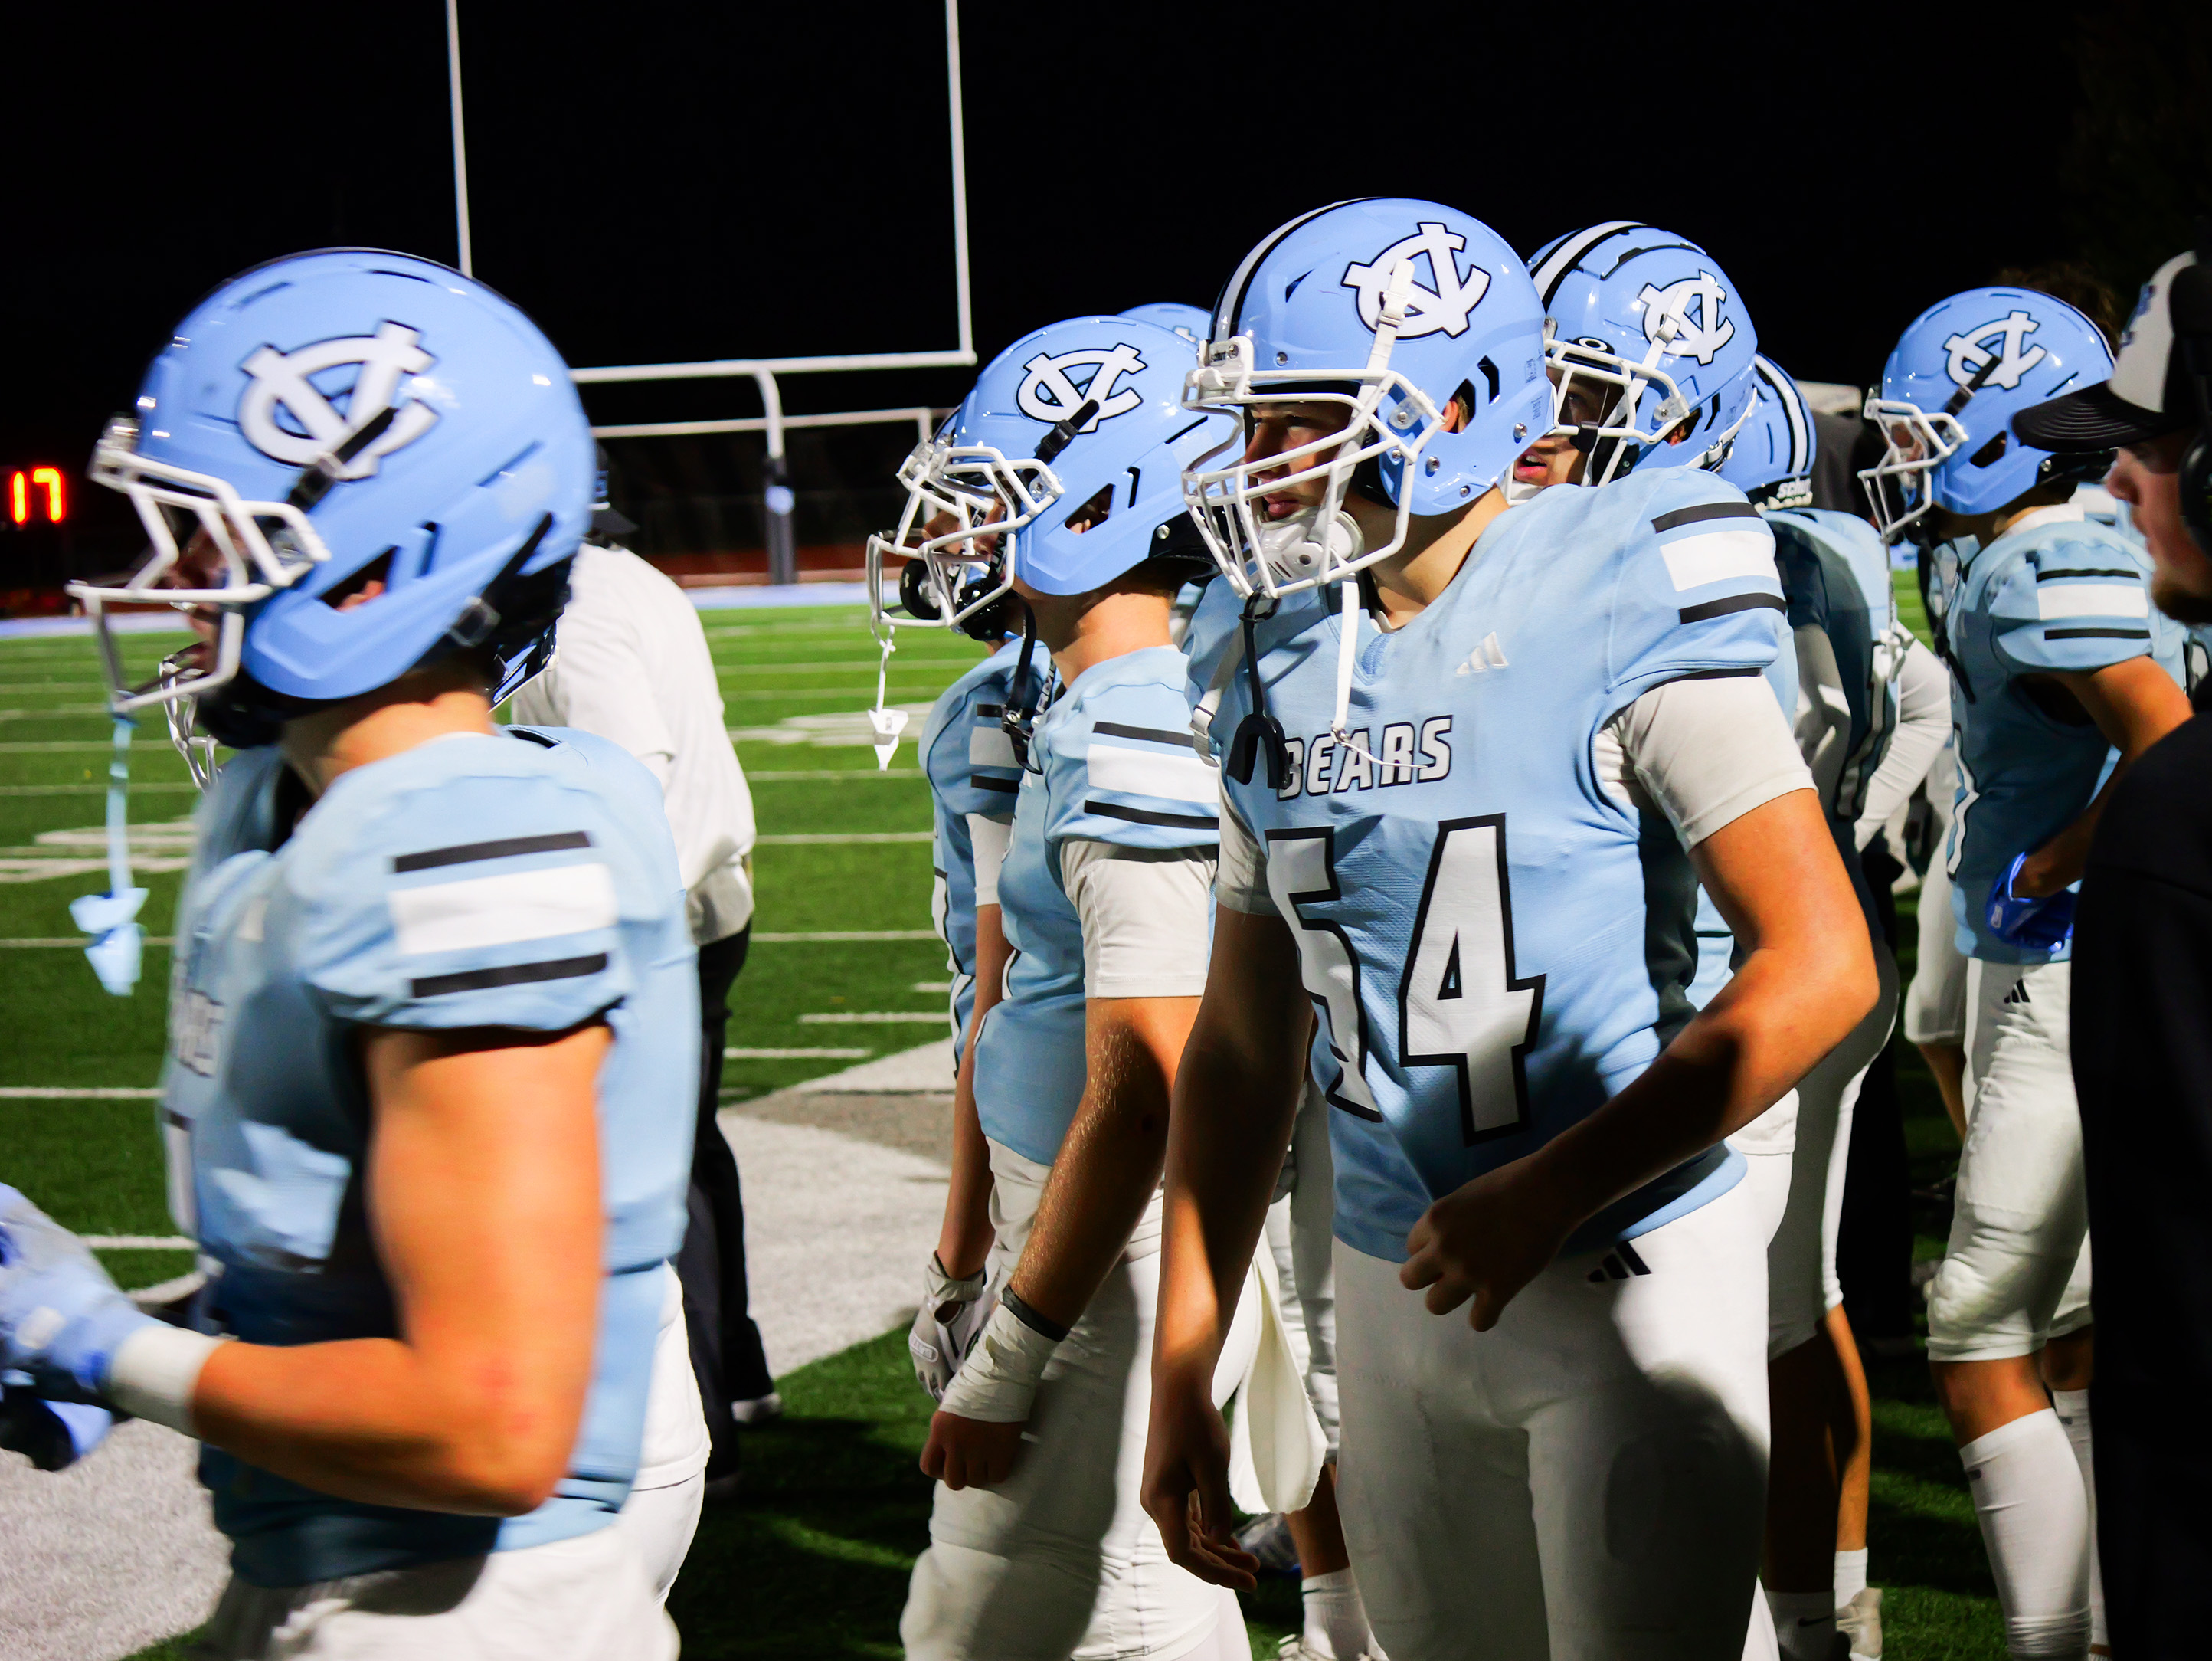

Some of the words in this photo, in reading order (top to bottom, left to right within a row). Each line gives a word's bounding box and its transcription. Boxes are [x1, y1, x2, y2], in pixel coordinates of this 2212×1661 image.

[11, 467, 66, 525] 17
[1276, 714, 1454, 802] BEARS
[1265, 812, 1547, 1147] 54
